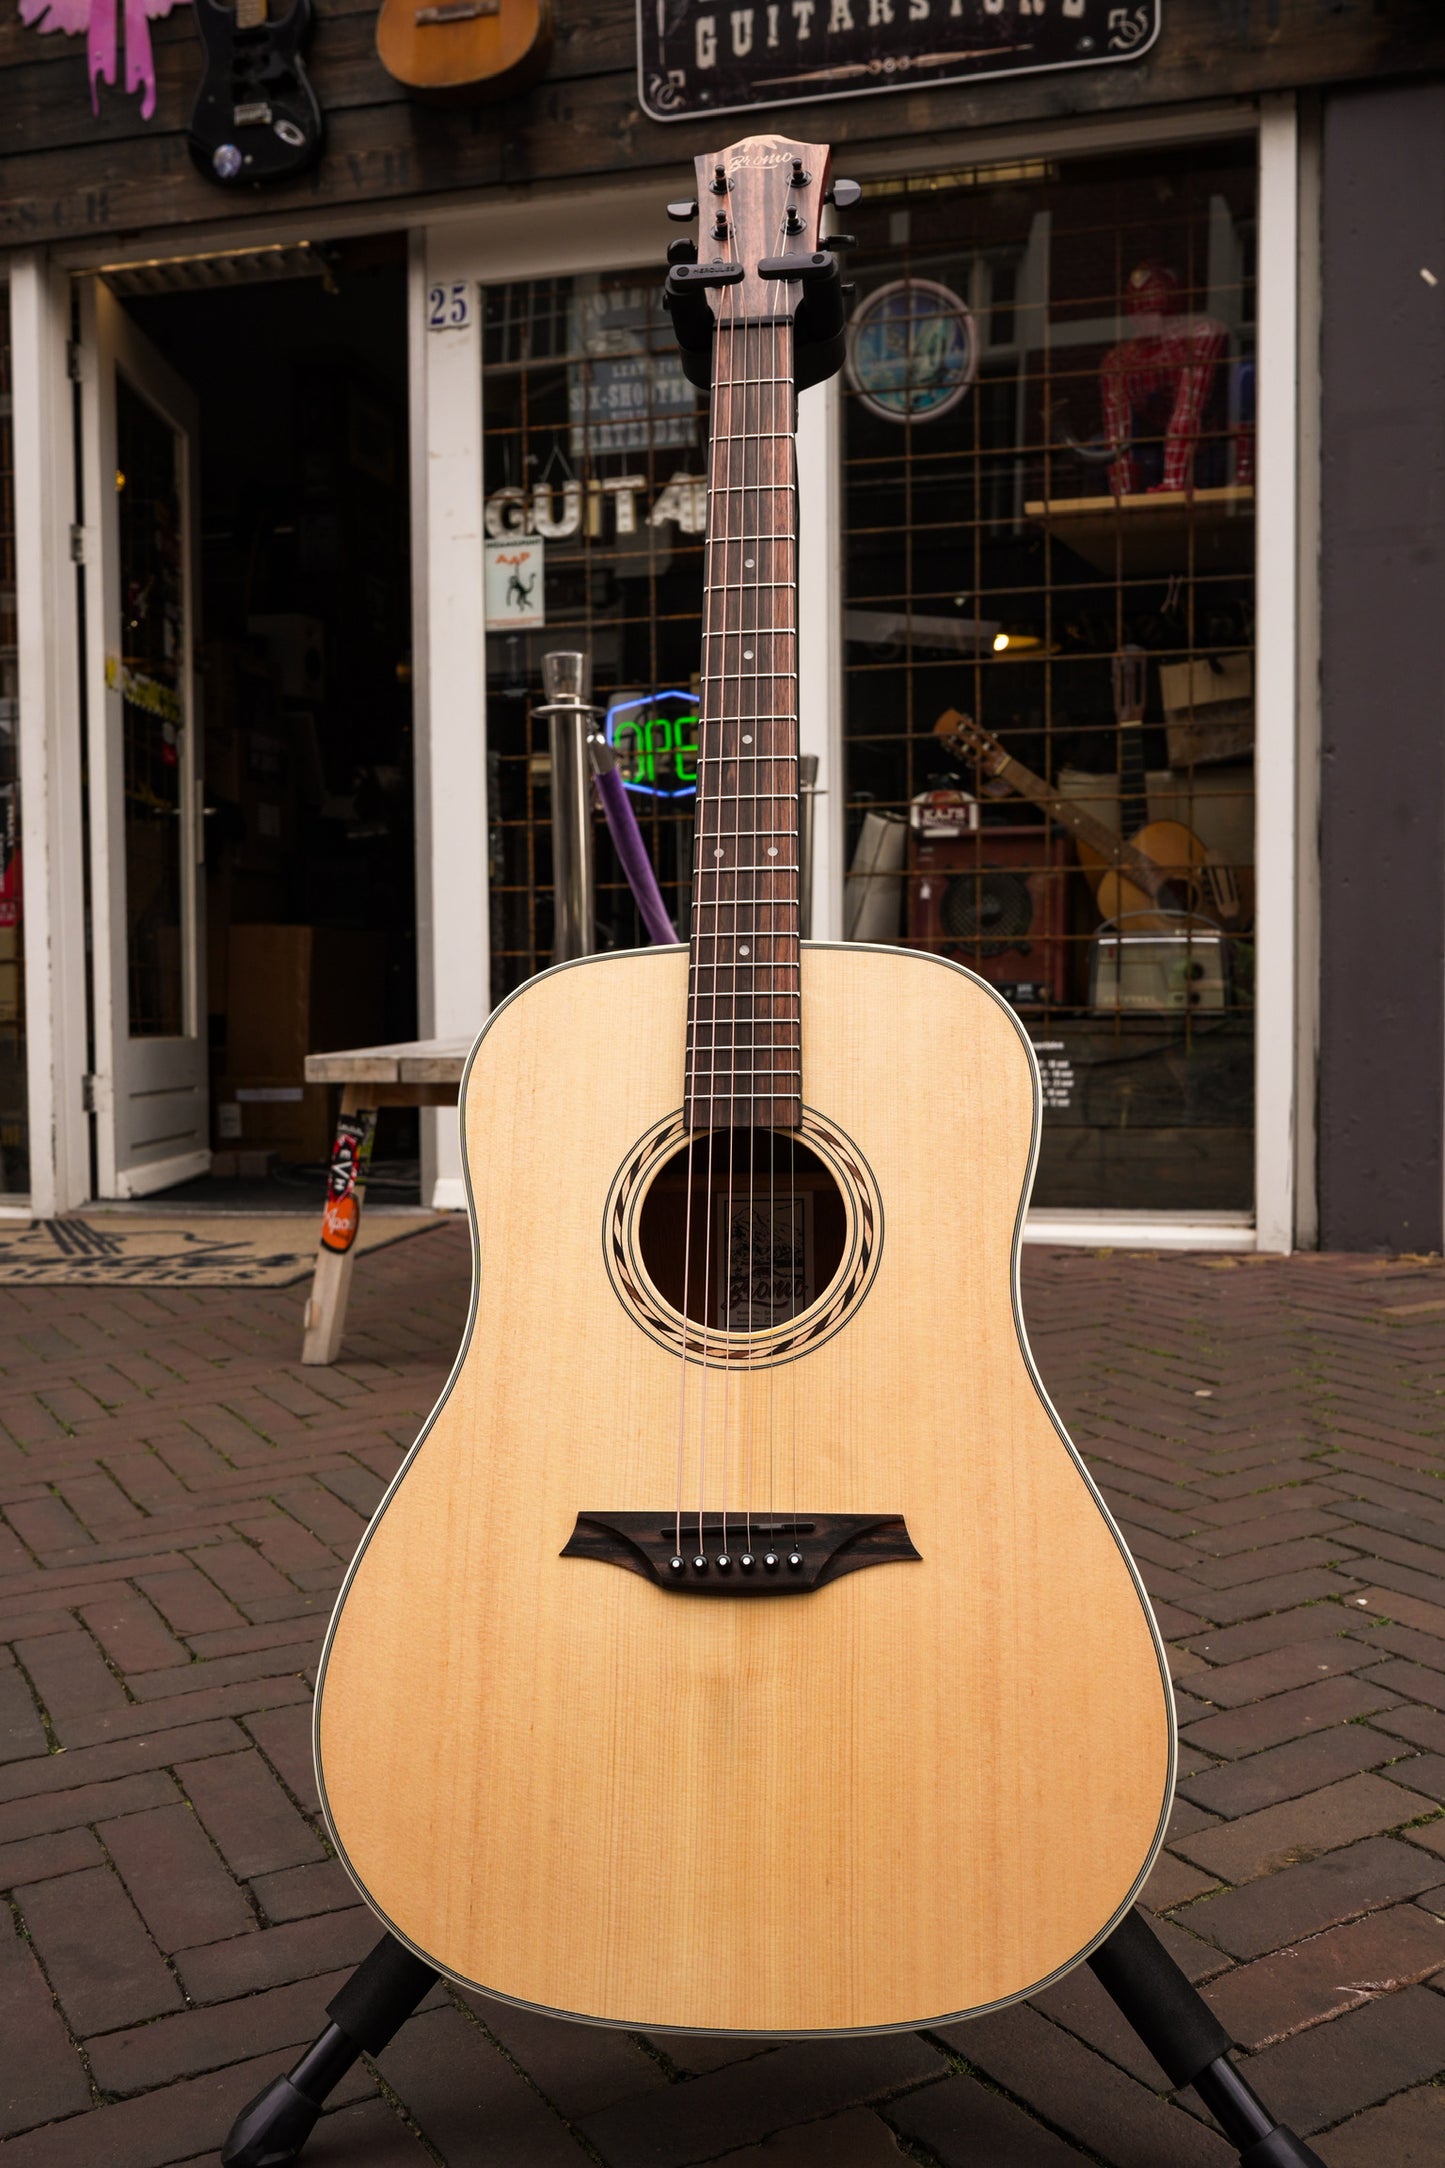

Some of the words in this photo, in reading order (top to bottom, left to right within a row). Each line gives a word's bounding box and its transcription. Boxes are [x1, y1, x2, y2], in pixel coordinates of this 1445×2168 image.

[725, 152, 793, 173] Bromo
[431, 285, 467, 323] 25
[614, 716, 698, 783] OPE
